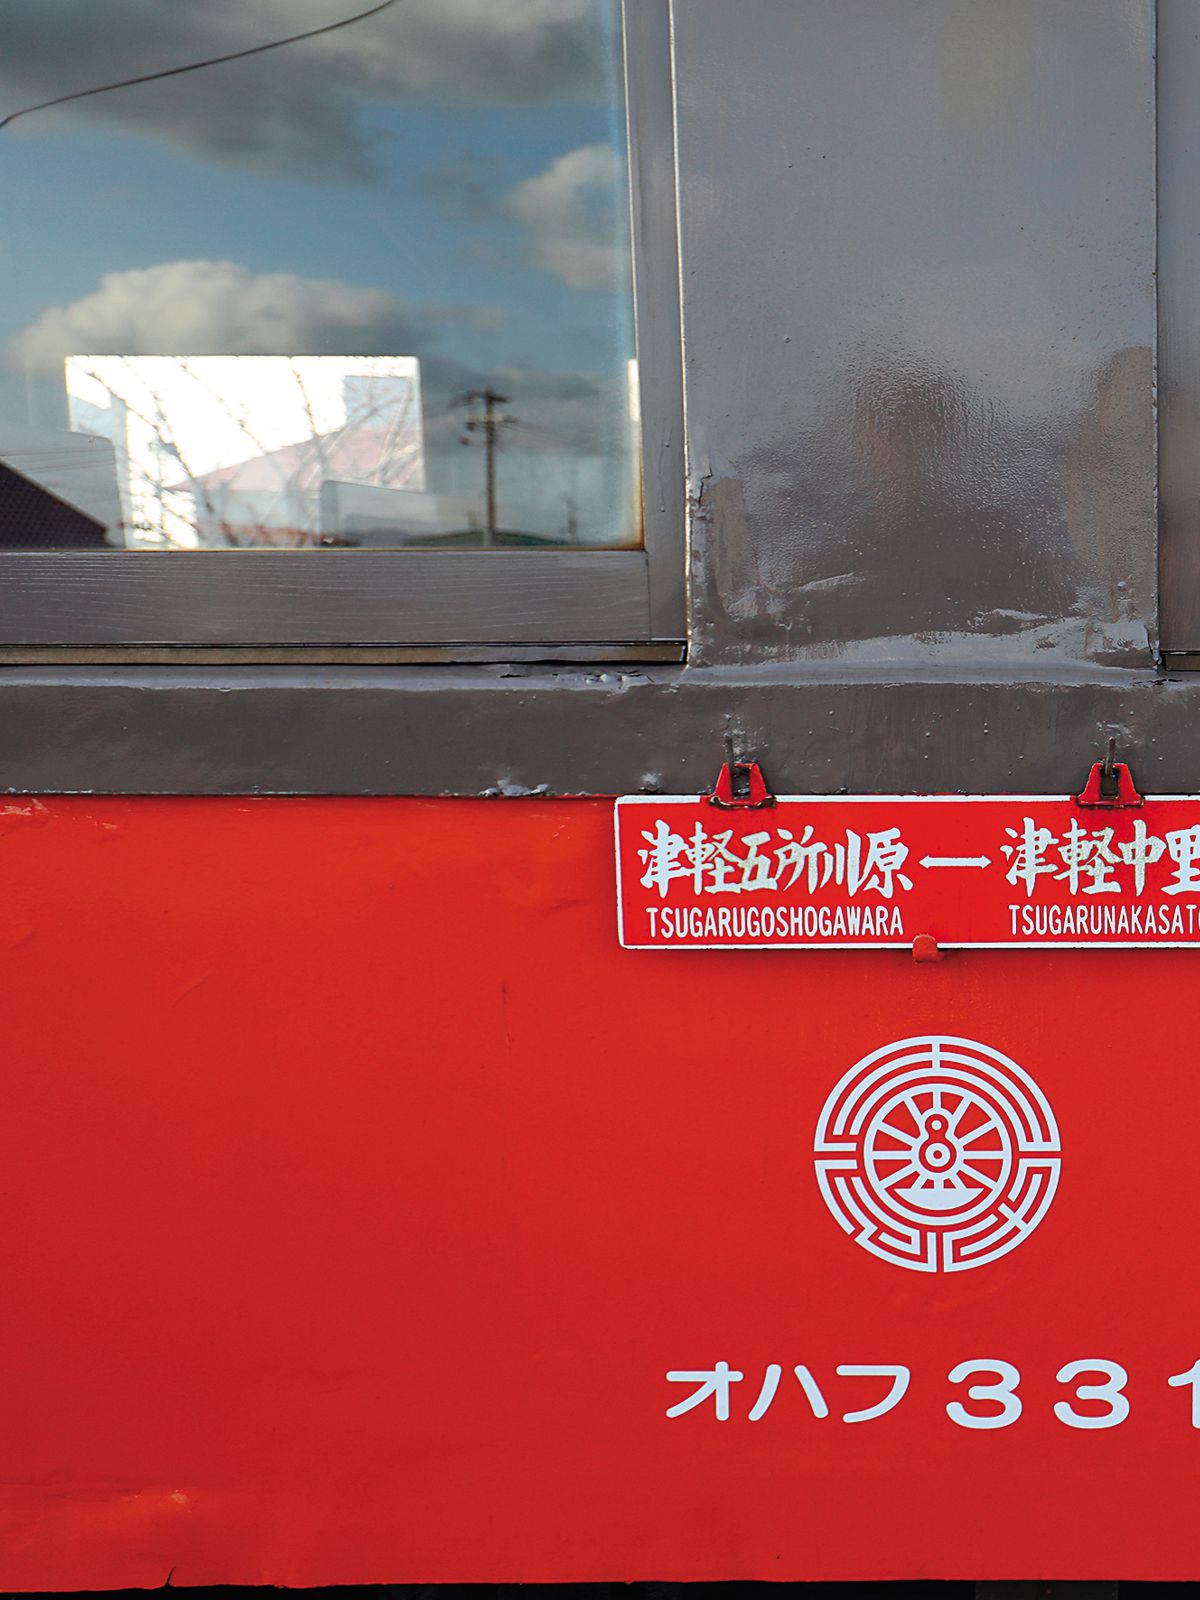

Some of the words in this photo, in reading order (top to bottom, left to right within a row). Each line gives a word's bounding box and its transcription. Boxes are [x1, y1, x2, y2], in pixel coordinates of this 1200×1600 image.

[637, 817, 913, 898] 津軽五所川原
[646, 905, 904, 938] TSUGARUGOSHOGAWARA
